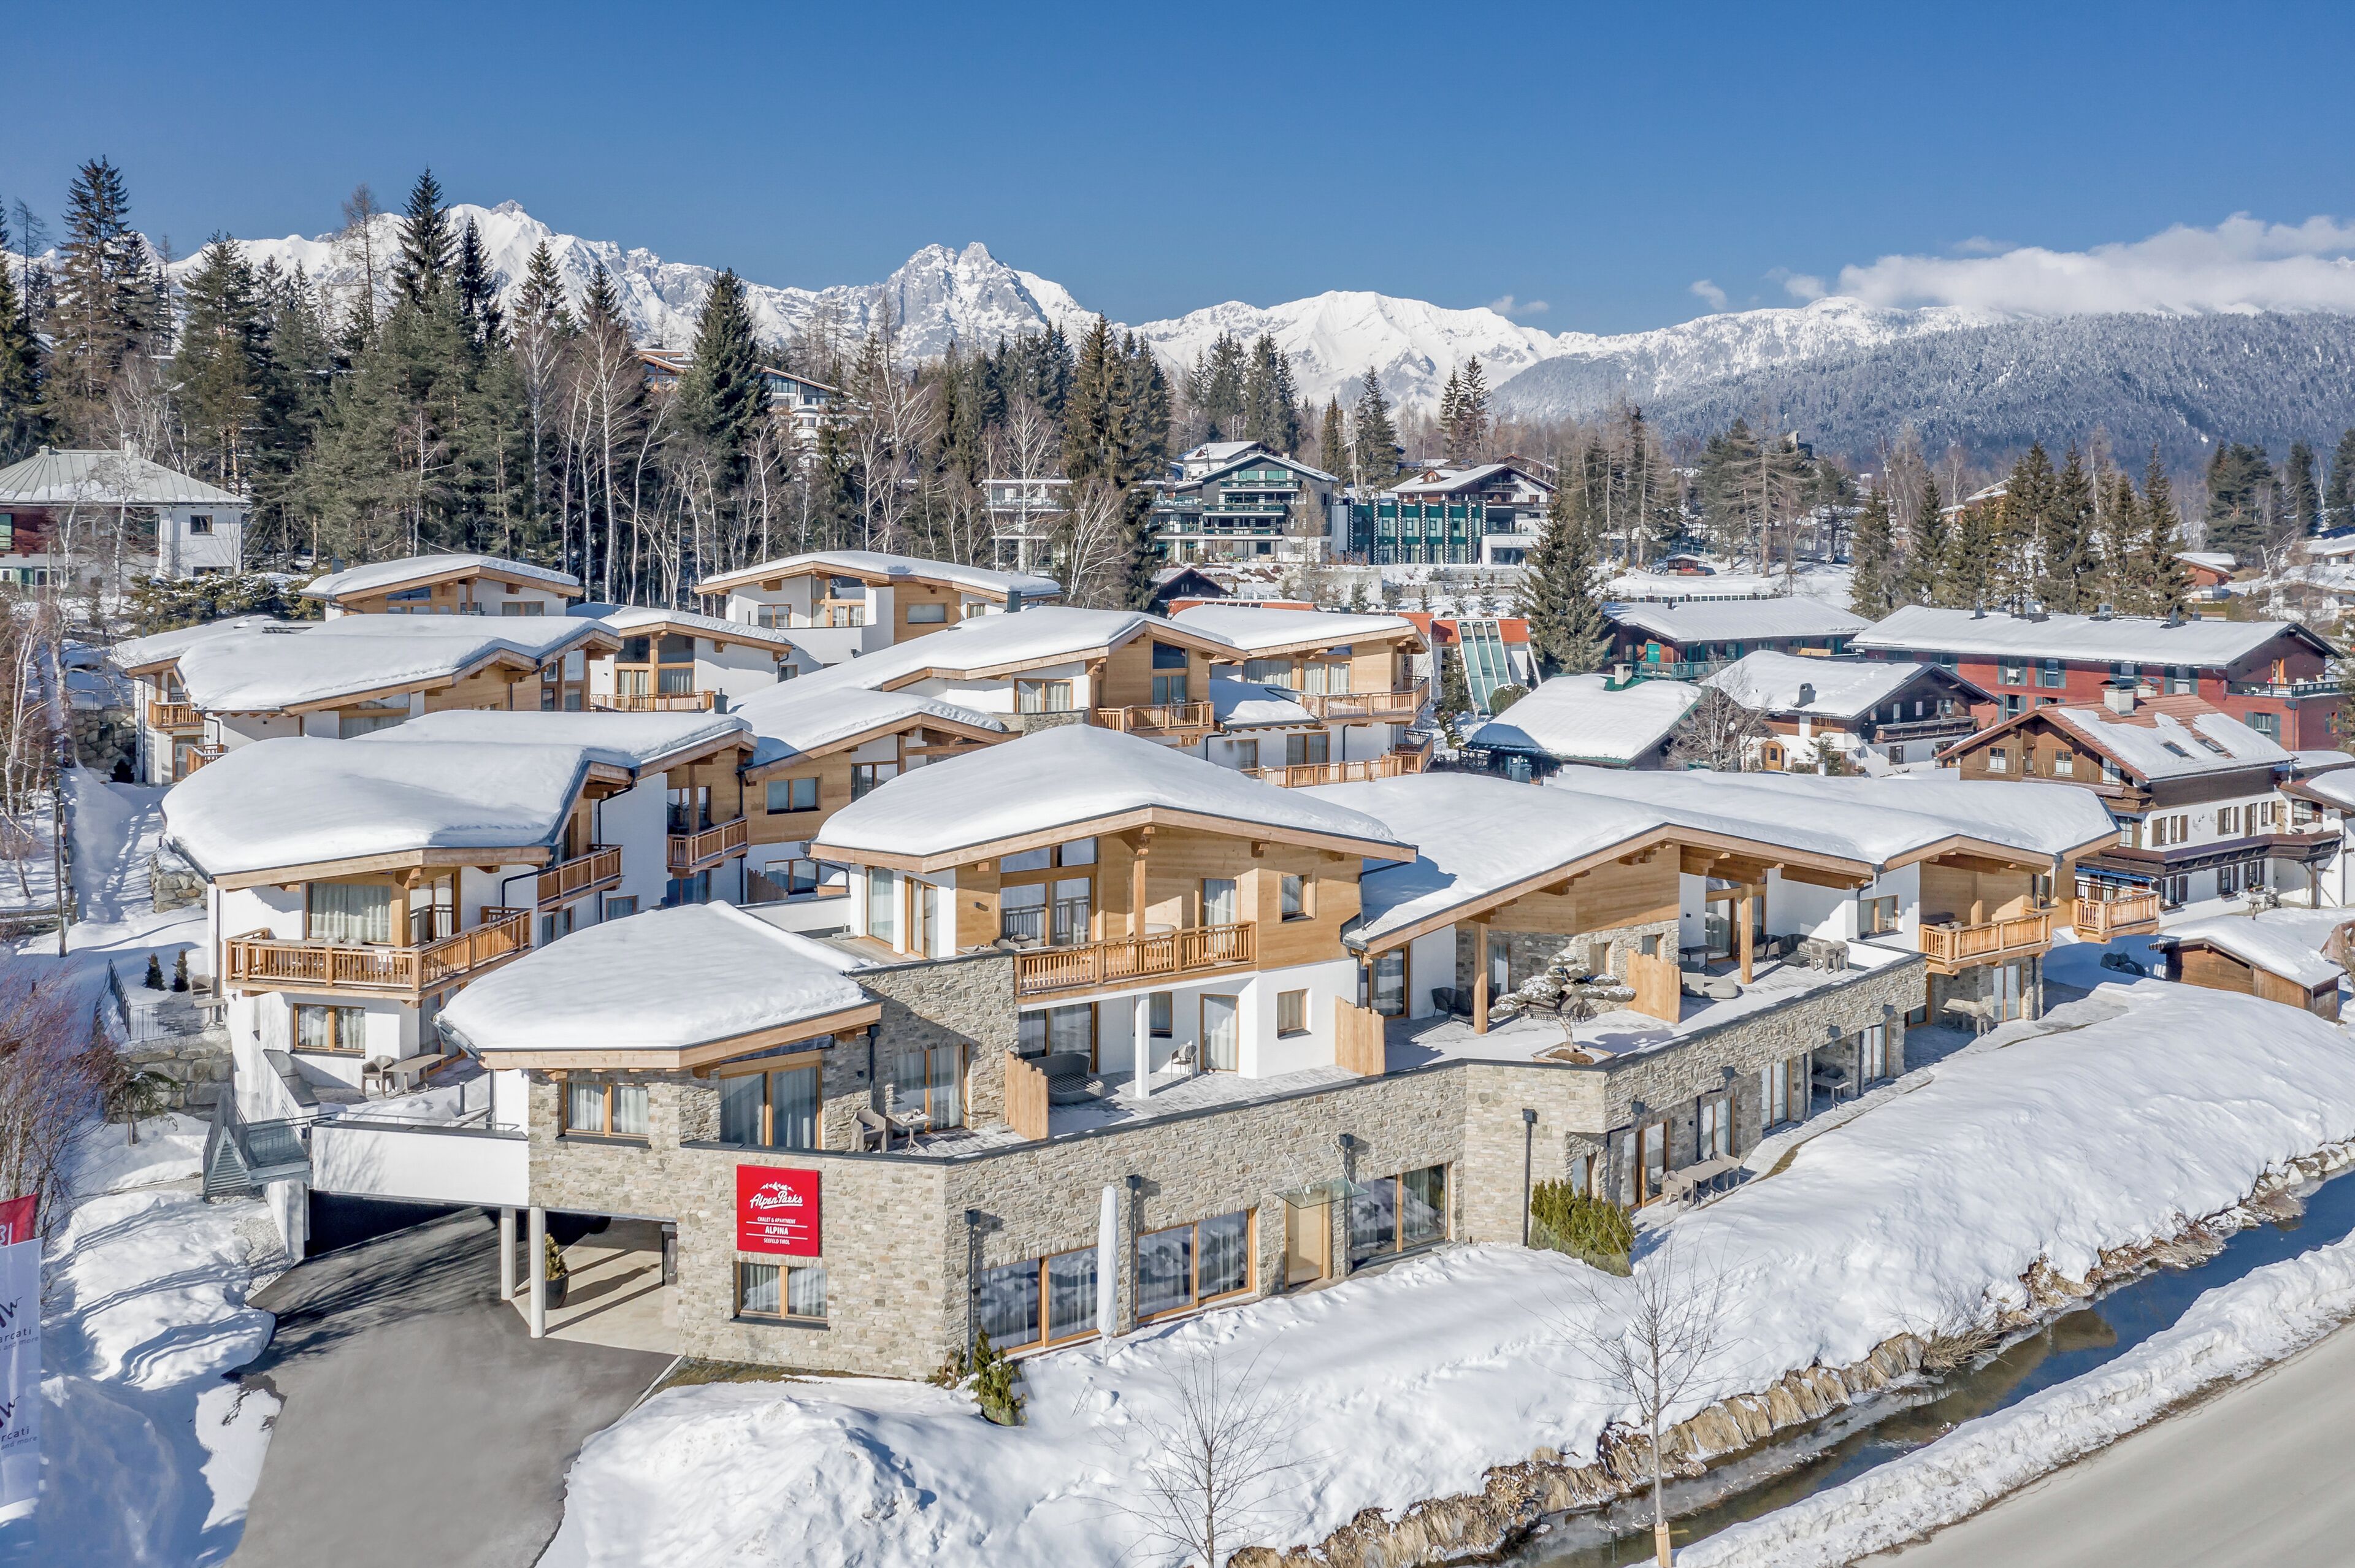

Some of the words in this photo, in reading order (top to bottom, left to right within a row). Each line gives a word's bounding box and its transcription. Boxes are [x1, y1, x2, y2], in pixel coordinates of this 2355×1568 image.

[765, 1226, 789, 1236] ALPINA
[0, 1326, 31, 1343] arcati
[4, 1341, 17, 1350] and
[19, 1336, 39, 1345] more
[1, 1426, 30, 1442] rcati
[1, 1441, 15, 1450] and
[17, 1436, 38, 1446] more
